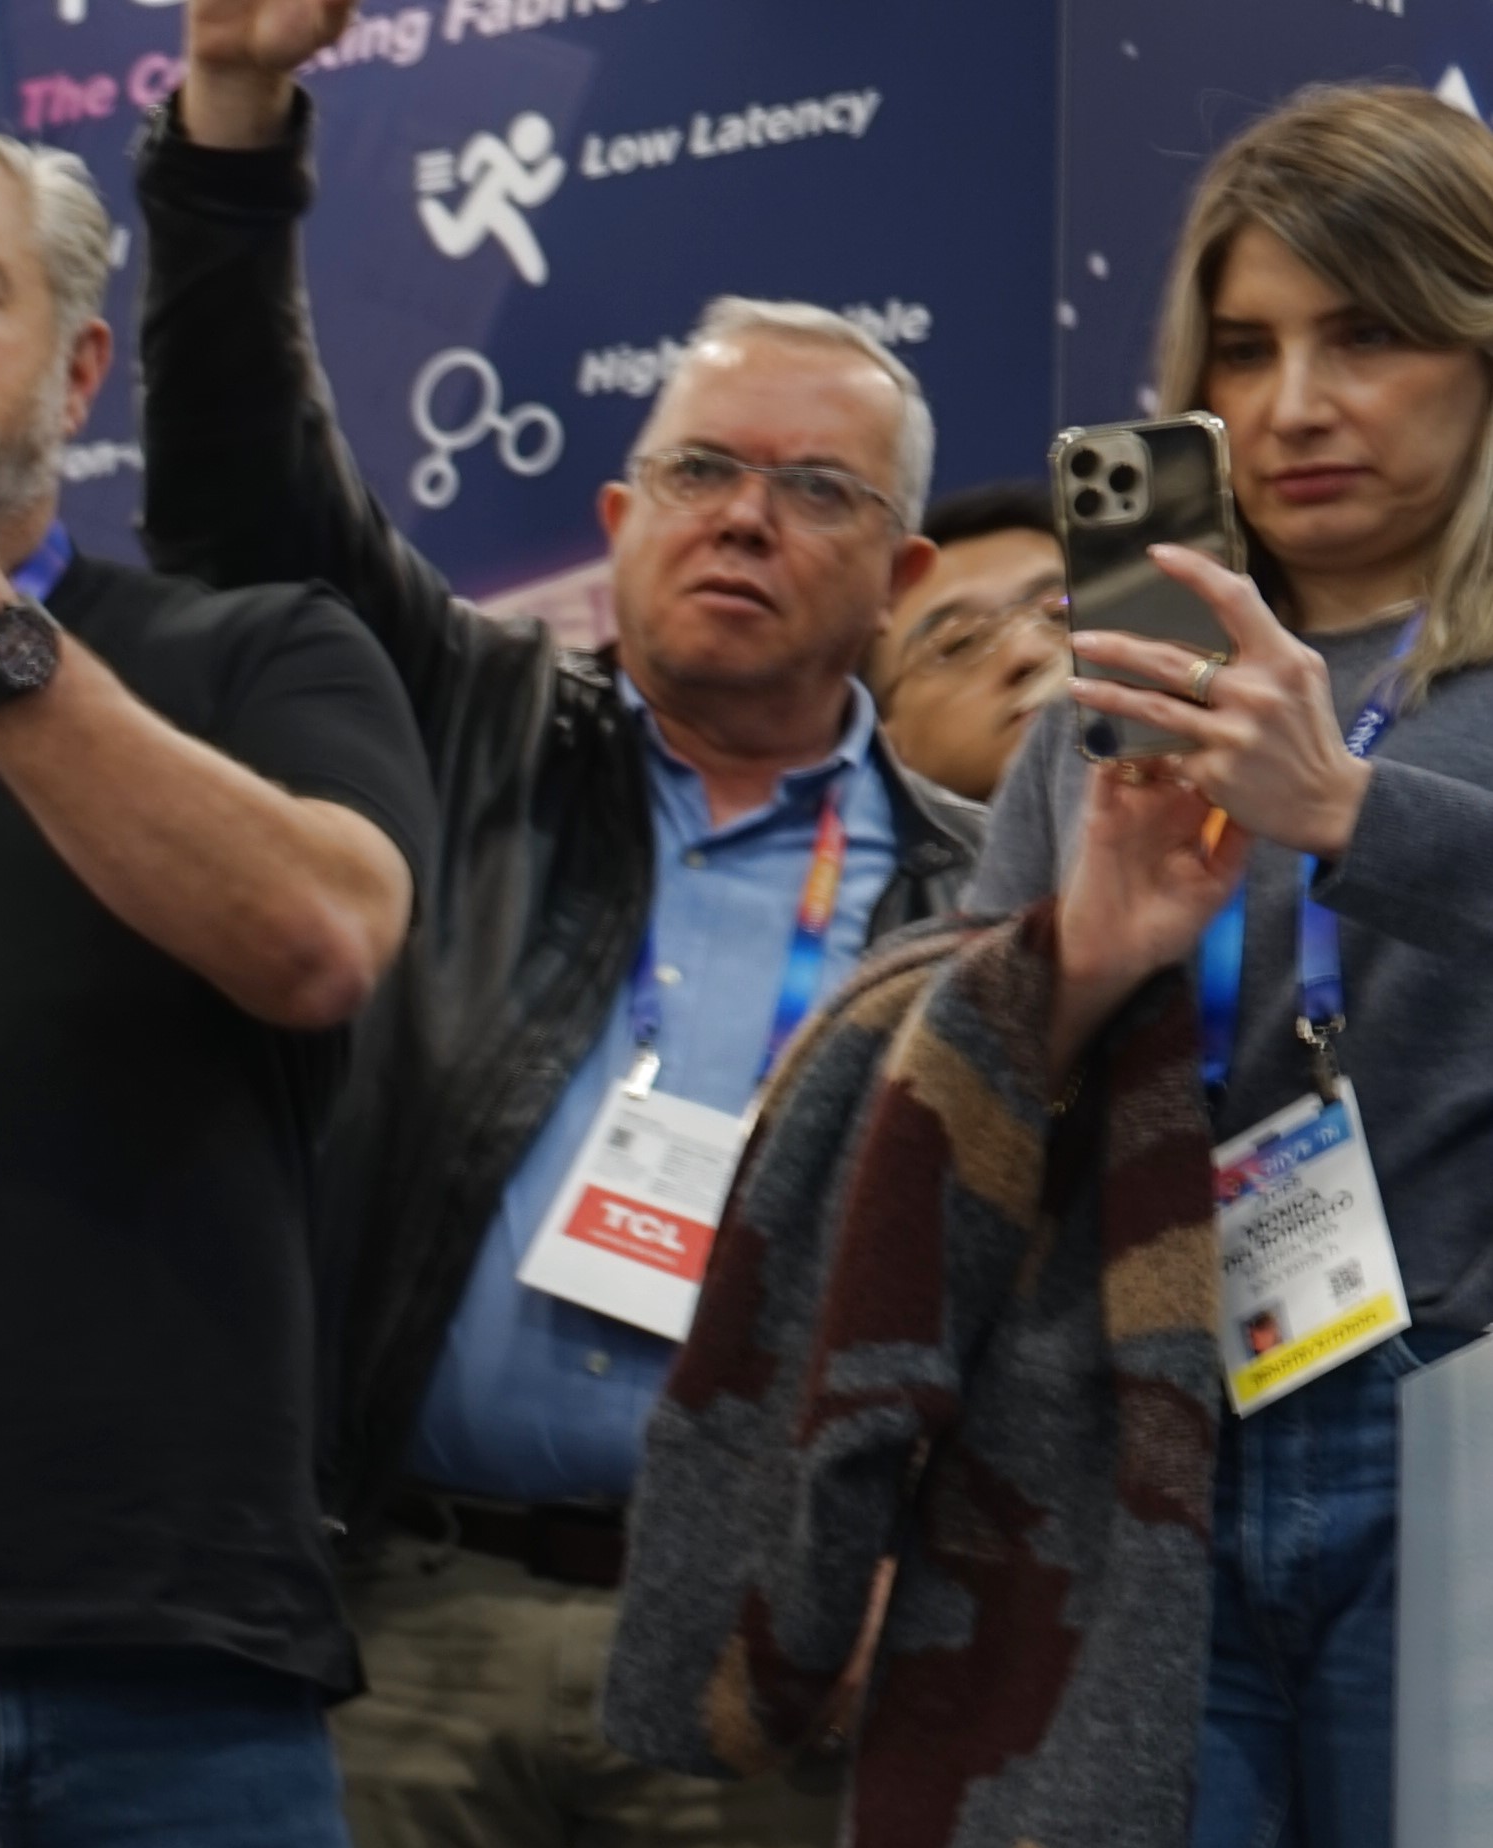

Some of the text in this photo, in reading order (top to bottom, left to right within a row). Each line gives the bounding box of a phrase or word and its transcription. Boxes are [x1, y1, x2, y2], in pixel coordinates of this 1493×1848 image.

[19, 72, 119, 130] The
[579, 86, 883, 179] Low Latency
[600, 1200, 688, 1254] TCL
